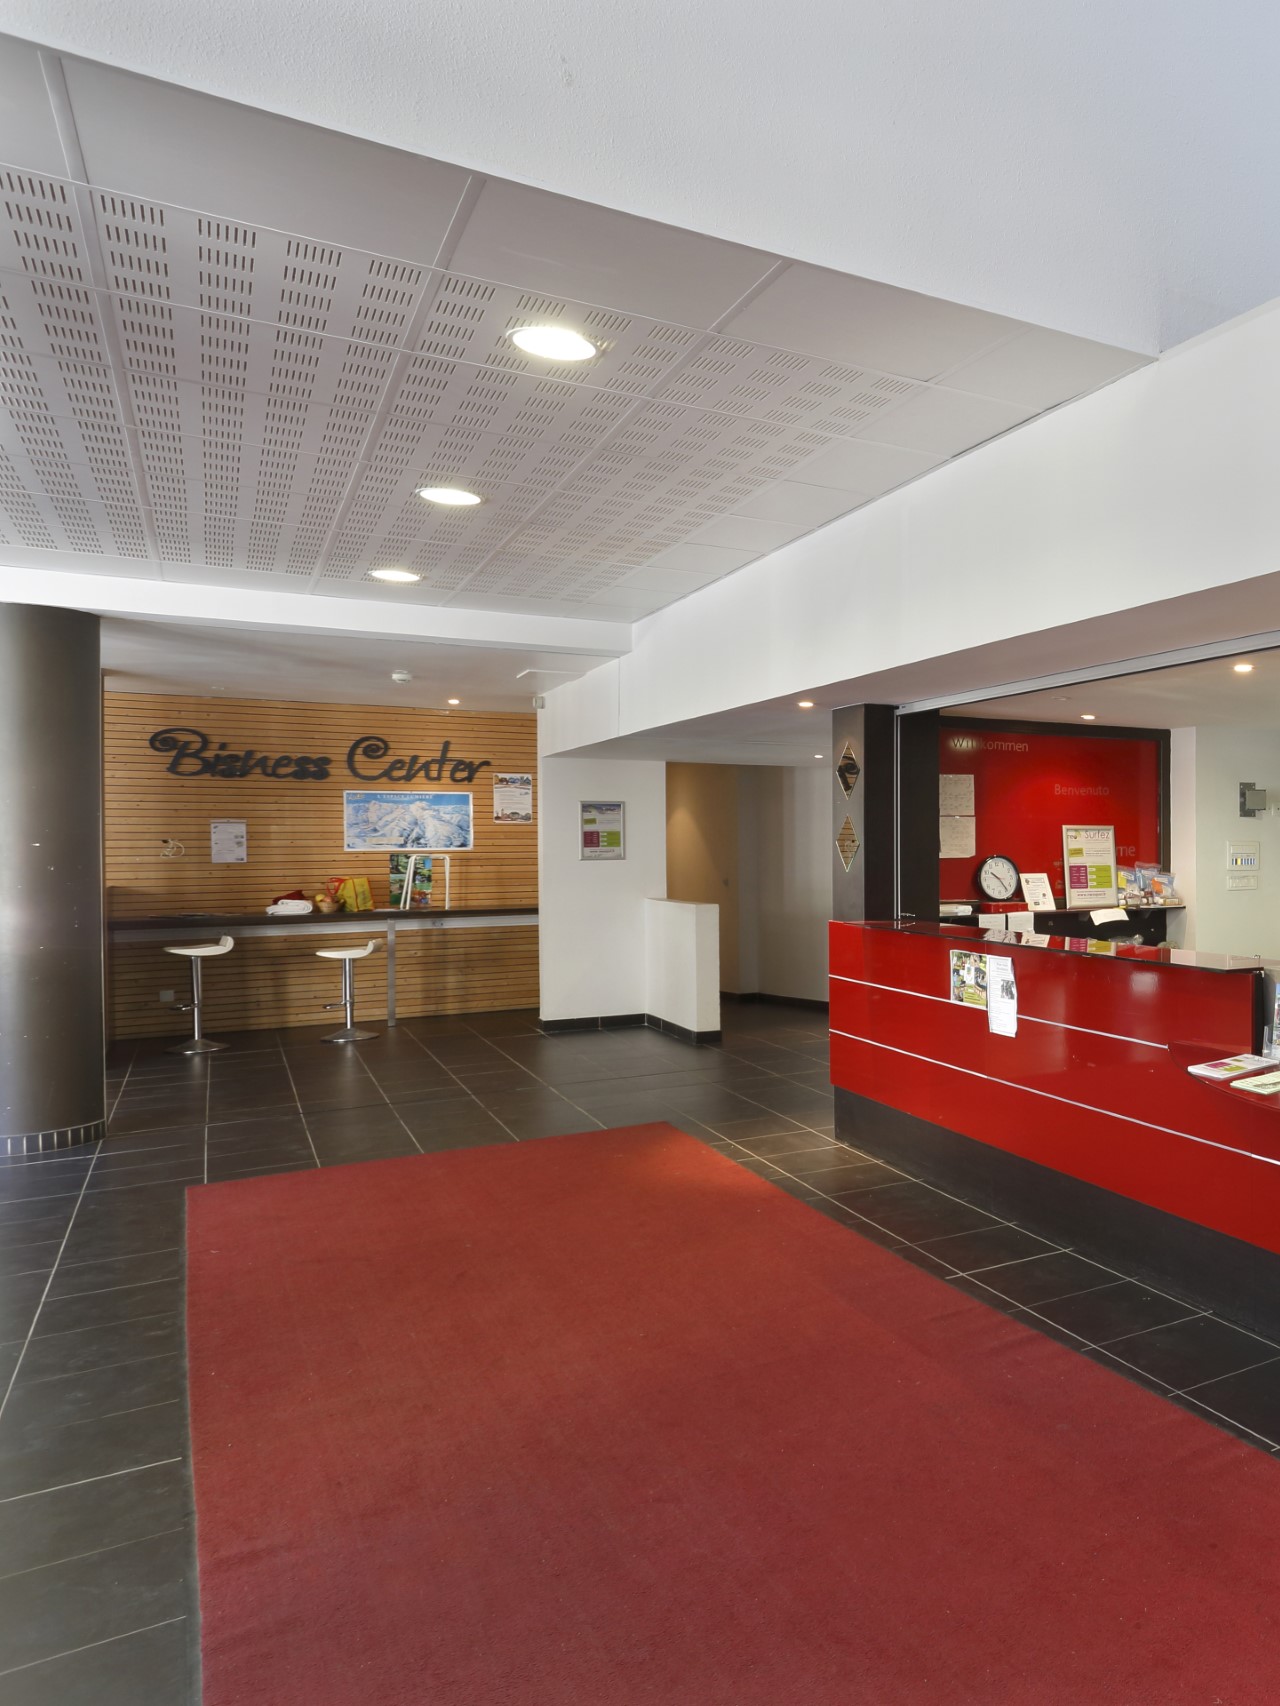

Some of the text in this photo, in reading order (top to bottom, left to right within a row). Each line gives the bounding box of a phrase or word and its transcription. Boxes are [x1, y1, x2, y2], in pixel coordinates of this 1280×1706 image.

[952, 737, 1029, 752] Willkommen
[149, 728, 491, 783] Bisness Center
[1054, 784, 1110, 796] Benvenuto
